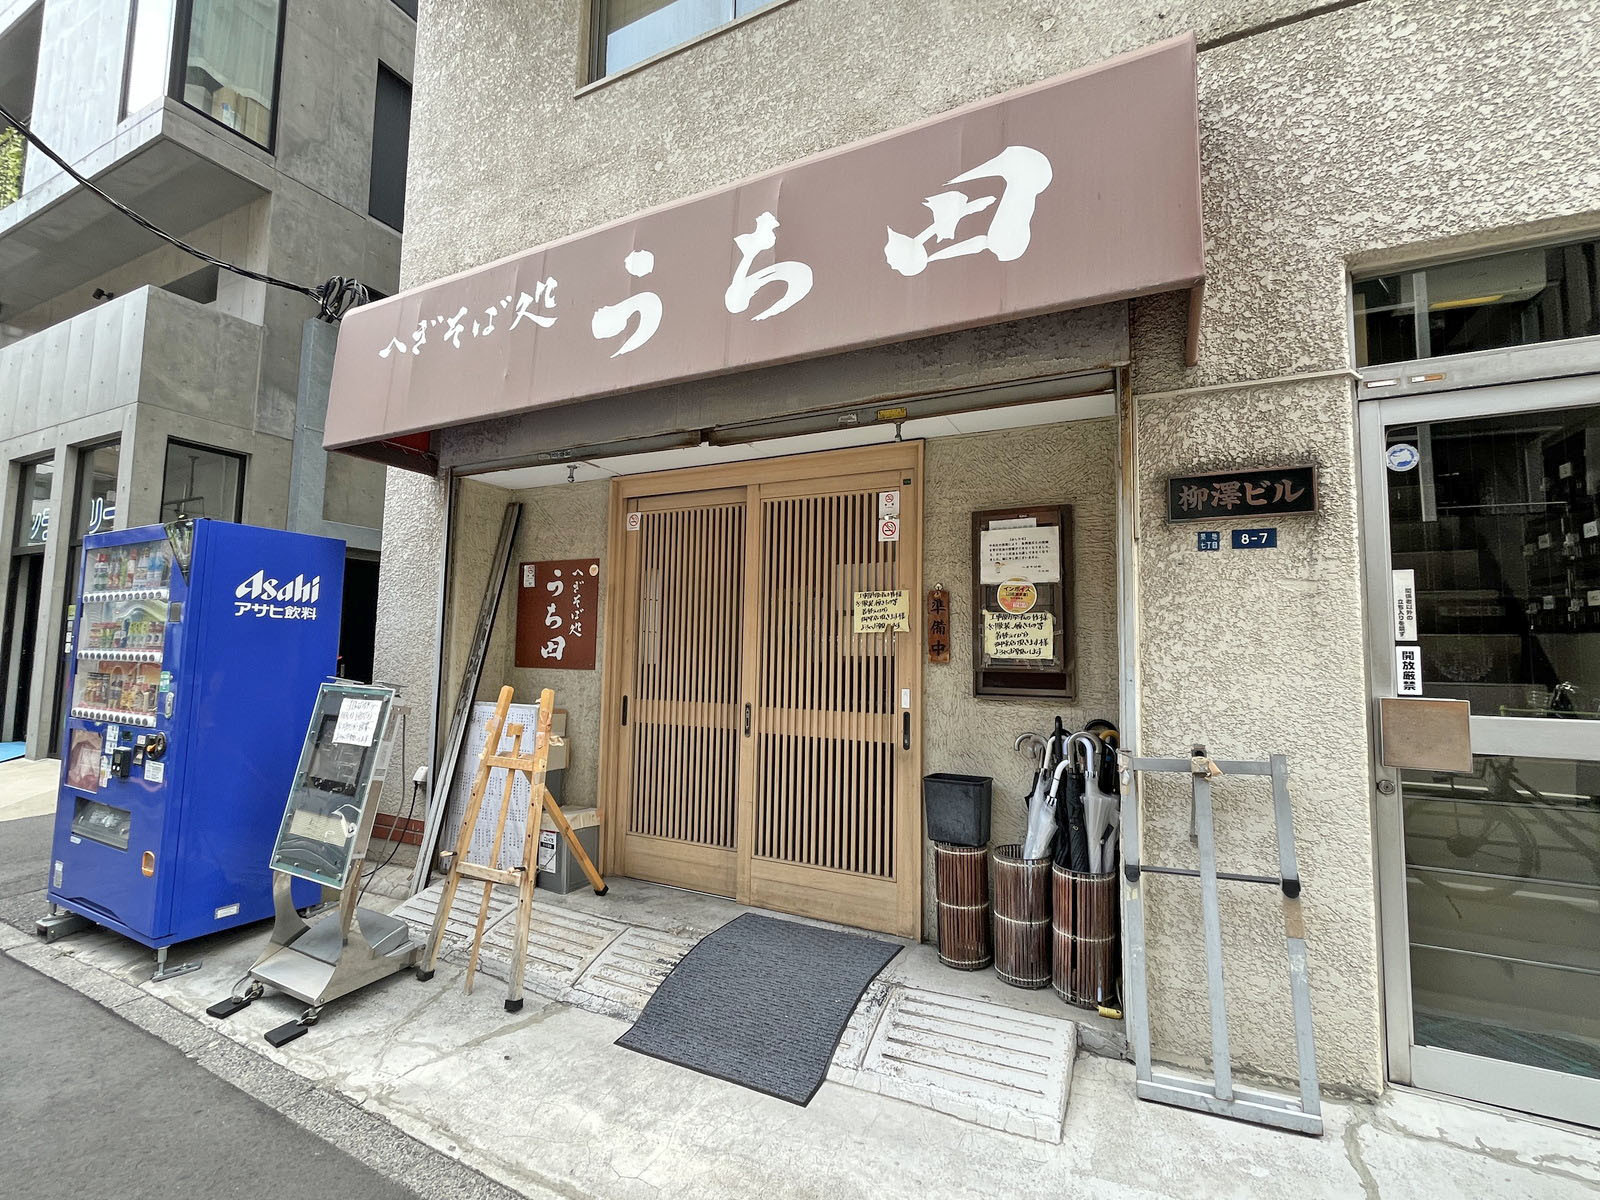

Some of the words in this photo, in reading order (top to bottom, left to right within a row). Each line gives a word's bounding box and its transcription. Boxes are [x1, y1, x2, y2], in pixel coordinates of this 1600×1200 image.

[377, 276, 558, 358] へぎそば処
[591, 145, 1053, 358] うち田
[1177, 479, 1305, 512] 柳澤ビル
[1200, 541, 1218, 550] 七丁目
[1240, 532, 1268, 545] 8-7
[235, 569, 320, 604] Asahi
[568, 568, 585, 638] へぎそば処
[234, 601, 317, 621] アサヒ飲料
[540, 568, 566, 660] うち田
[931, 599, 947, 657] 準備中
[1401, 650, 1416, 691] 開放厳禁
